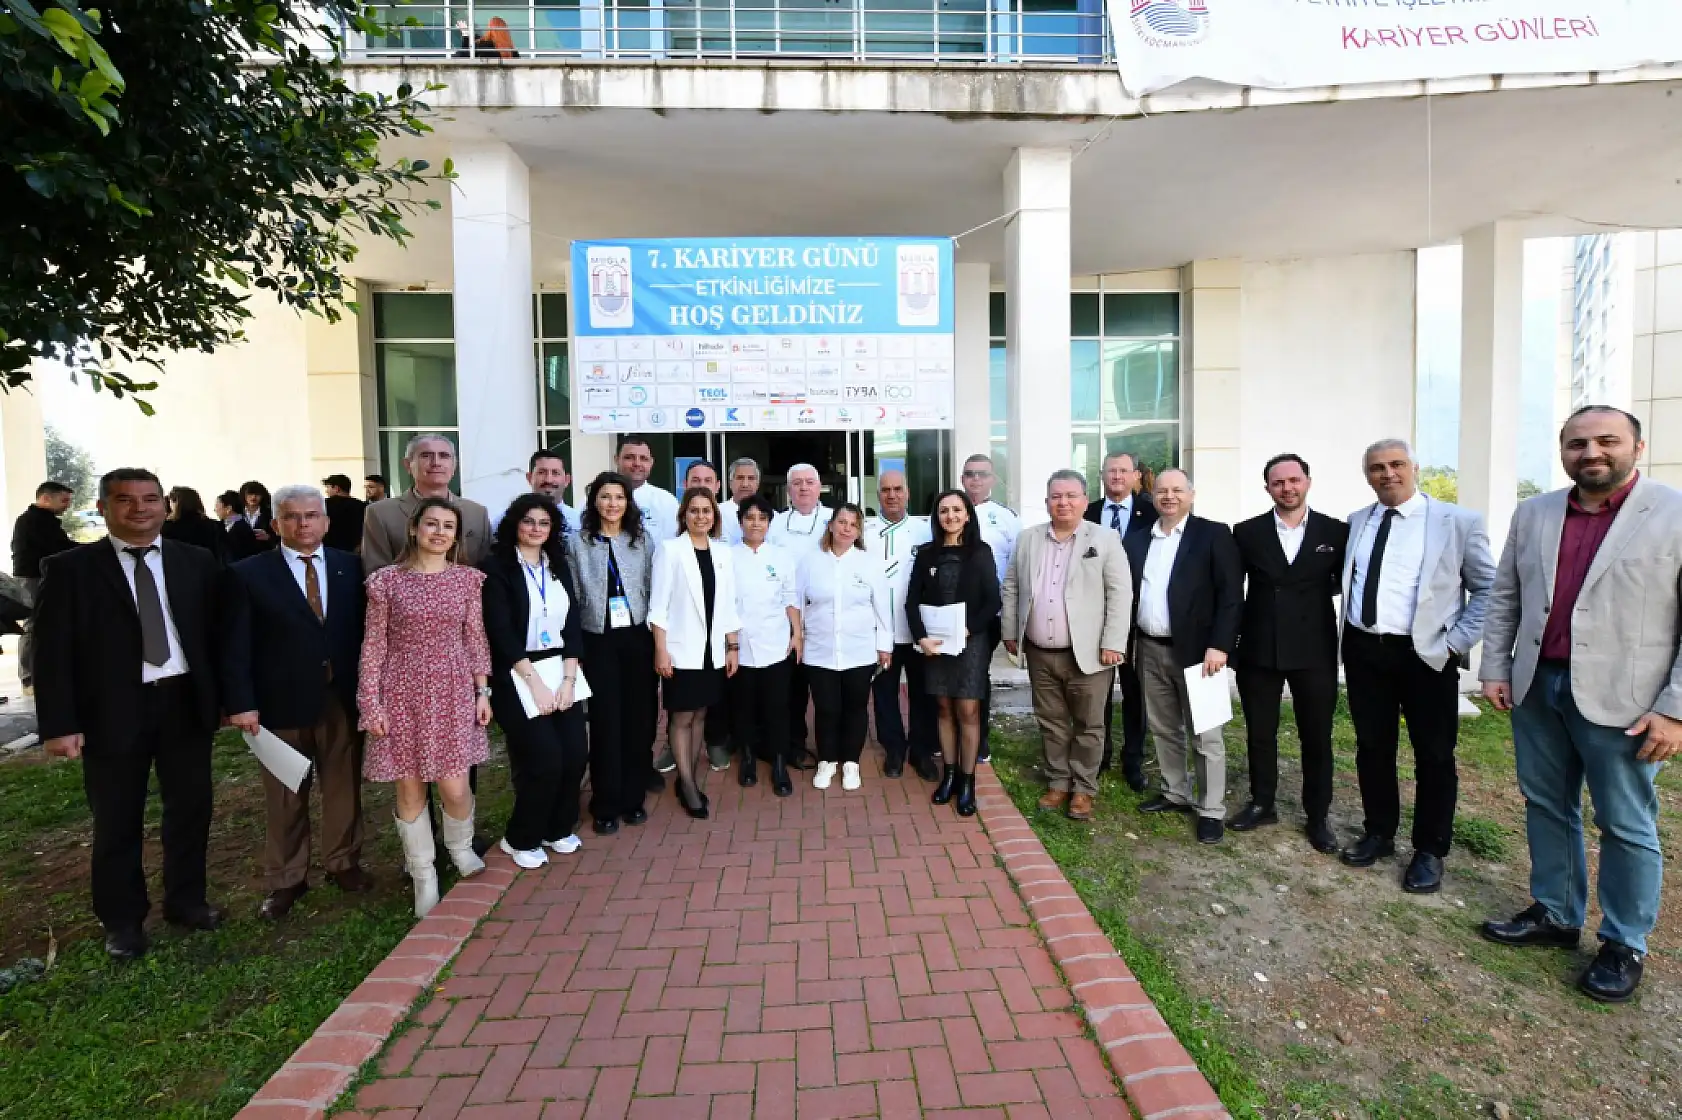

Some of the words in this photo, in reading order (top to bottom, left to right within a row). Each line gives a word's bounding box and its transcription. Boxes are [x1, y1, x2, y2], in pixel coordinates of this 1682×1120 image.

[1342, 24, 1469, 49] KARİYER
[1474, 15, 1599, 41] GÜNLERİ
[647, 250, 668, 269] 7.
[673, 243, 796, 269] KARİYER
[802, 242, 879, 268] GÜNÜ
[696, 275, 836, 296] ETKİNLİĞİMİZE
[669, 304, 724, 330] HOŞ
[731, 301, 863, 326] GELDİNİZ
